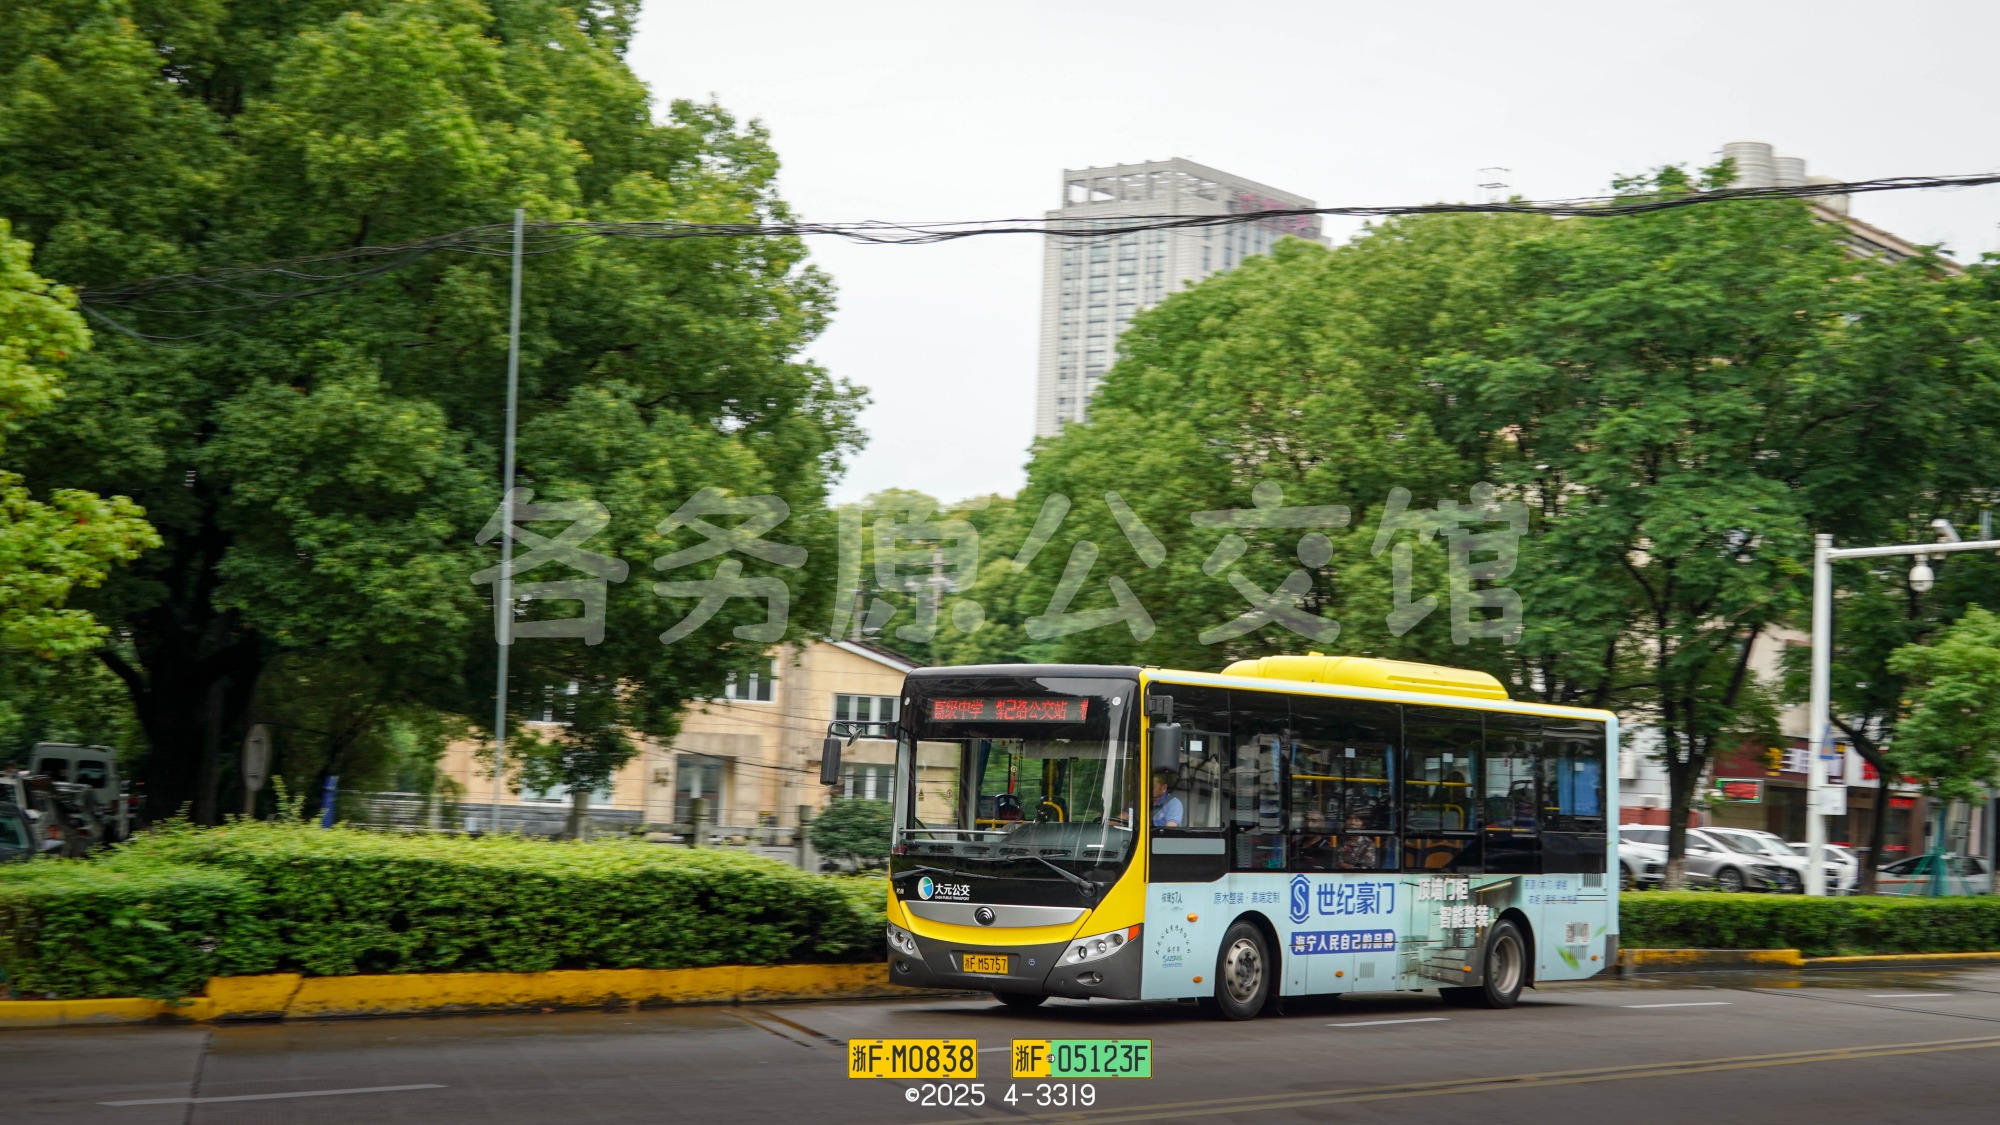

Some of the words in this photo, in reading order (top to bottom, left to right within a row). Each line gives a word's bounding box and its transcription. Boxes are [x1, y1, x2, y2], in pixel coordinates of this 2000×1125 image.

[934, 699, 984, 720] 高级中学
[935, 883, 970, 897] 大元公交
[1316, 881, 1395, 916] 世纪豪门
[1439, 904, 1489, 929] 智能整装
[1294, 932, 1394, 952] 海宁人民自己的品牌
